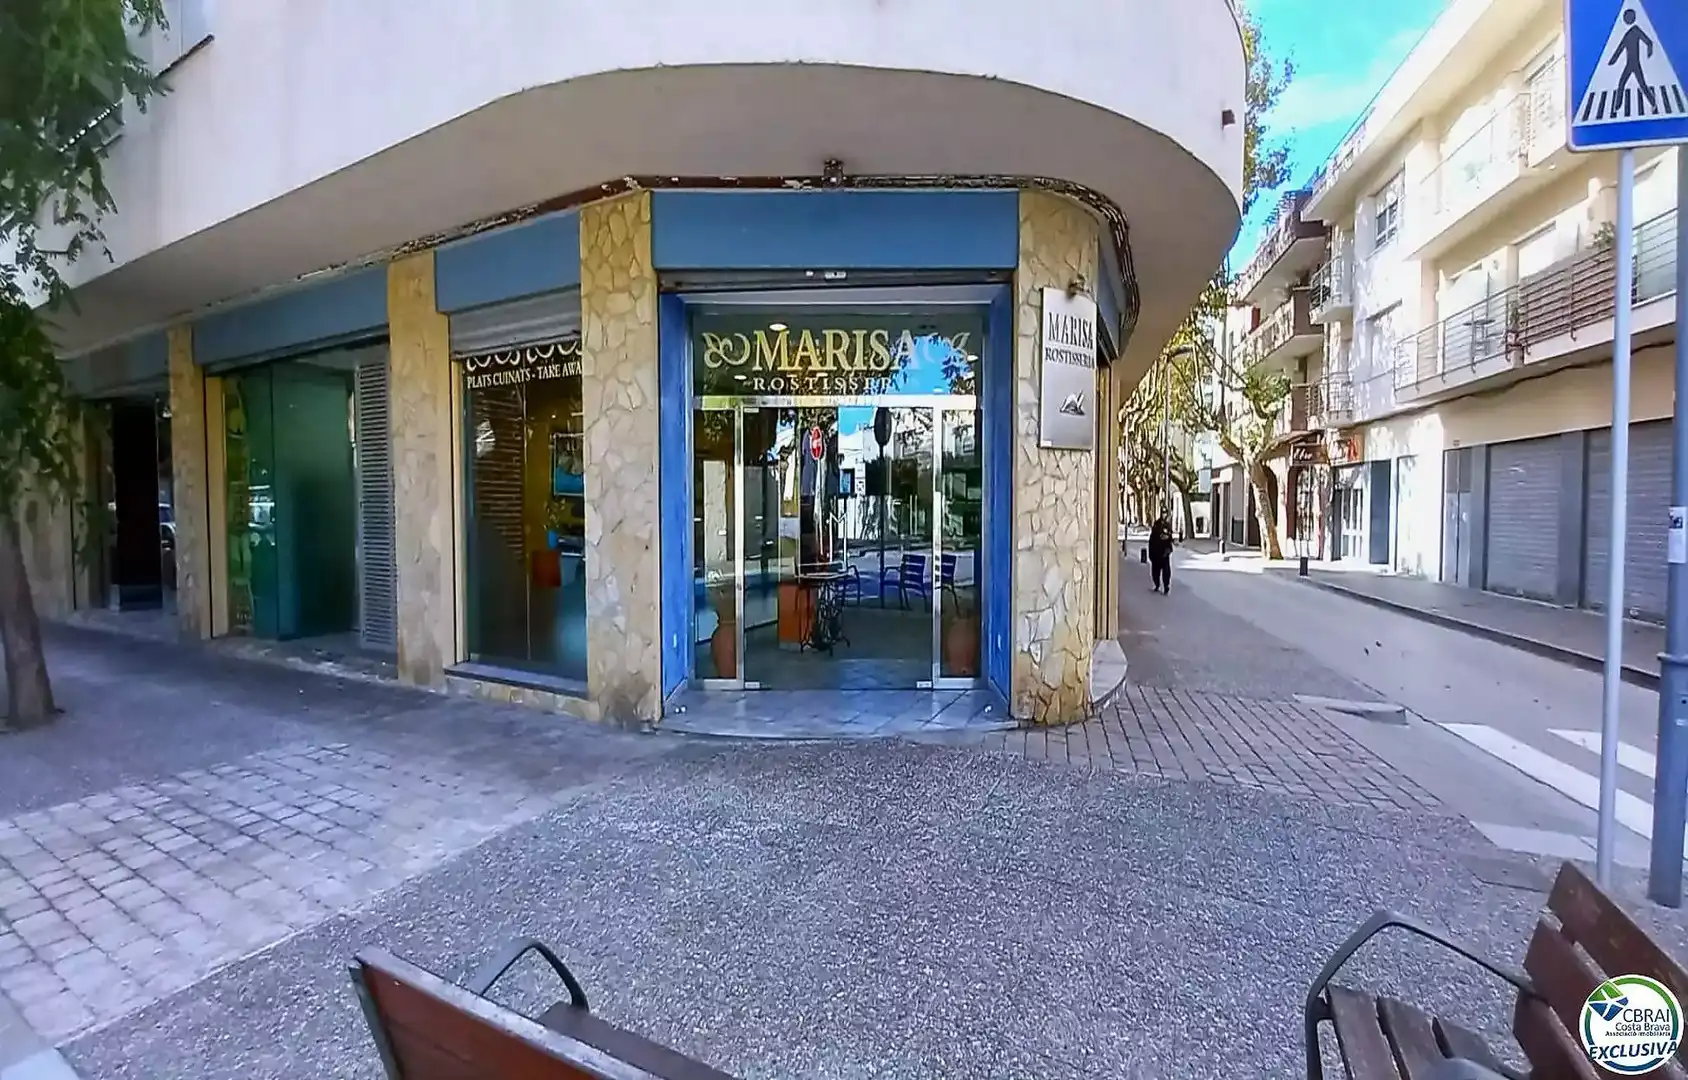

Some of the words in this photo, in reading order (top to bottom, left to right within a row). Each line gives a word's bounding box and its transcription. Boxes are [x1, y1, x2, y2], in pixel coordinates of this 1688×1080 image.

[1049, 312, 1093, 349] MARISA
[753, 329, 921, 371] MARISA
[1045, 347, 1095, 369] ROSTISSERIA
[468, 374, 492, 389] PLATS
[493, 368, 530, 385] CUINATS
[536, 364, 560, 379] TAKE
[562, 361, 582, 377] AWA
